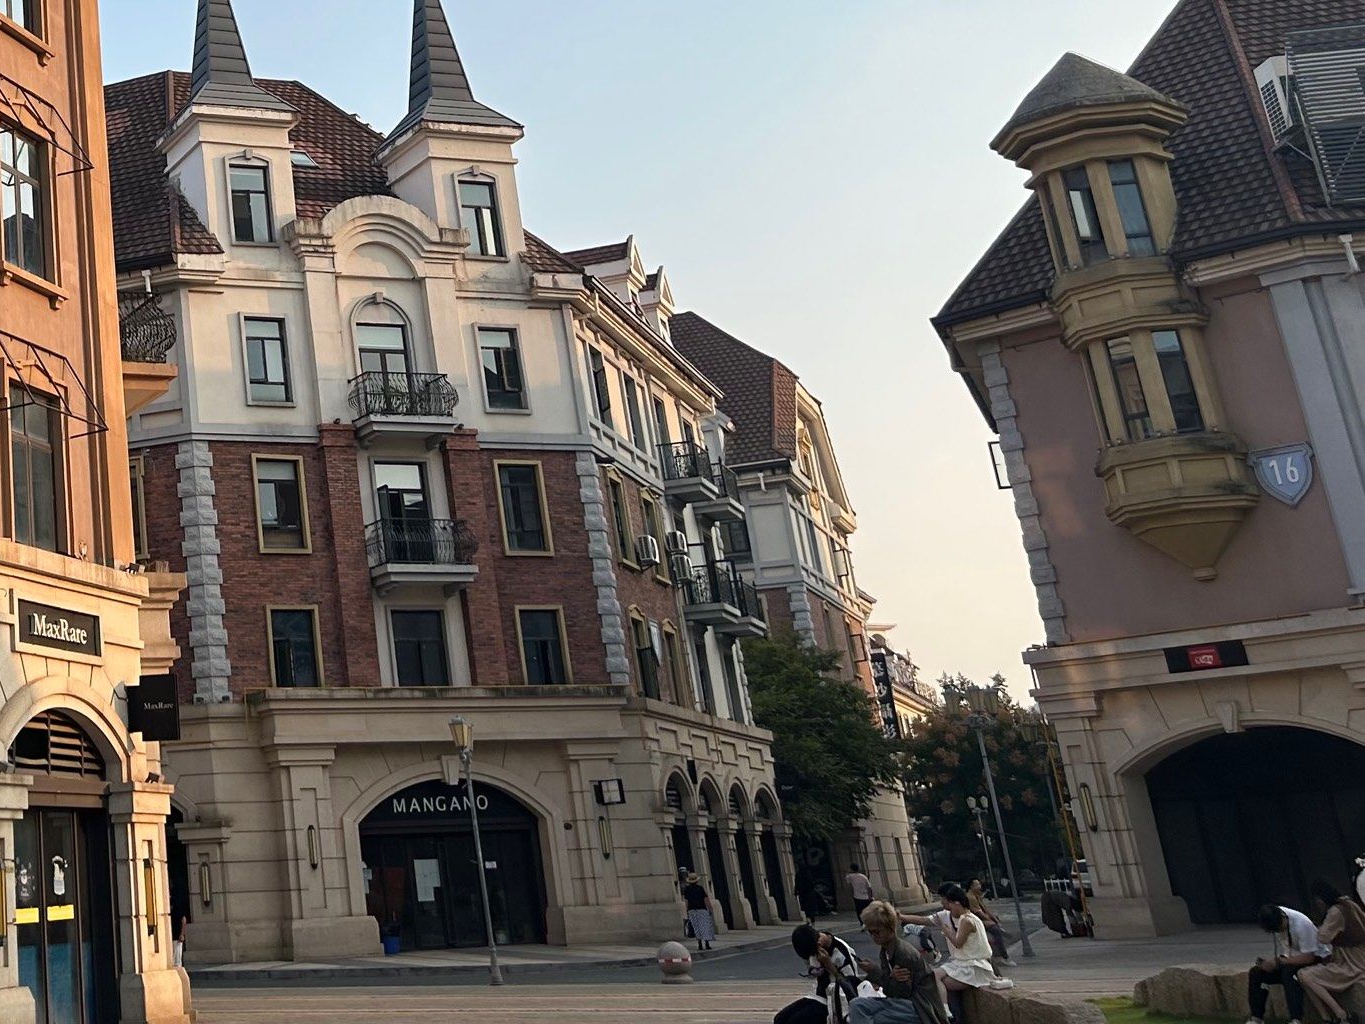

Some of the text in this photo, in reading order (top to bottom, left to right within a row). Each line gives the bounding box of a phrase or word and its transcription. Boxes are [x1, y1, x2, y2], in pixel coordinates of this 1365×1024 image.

[1269, 457, 1299, 485] 16
[33, 613, 88, 644] MaxRare
[393, 795, 489, 813] MANGANO
